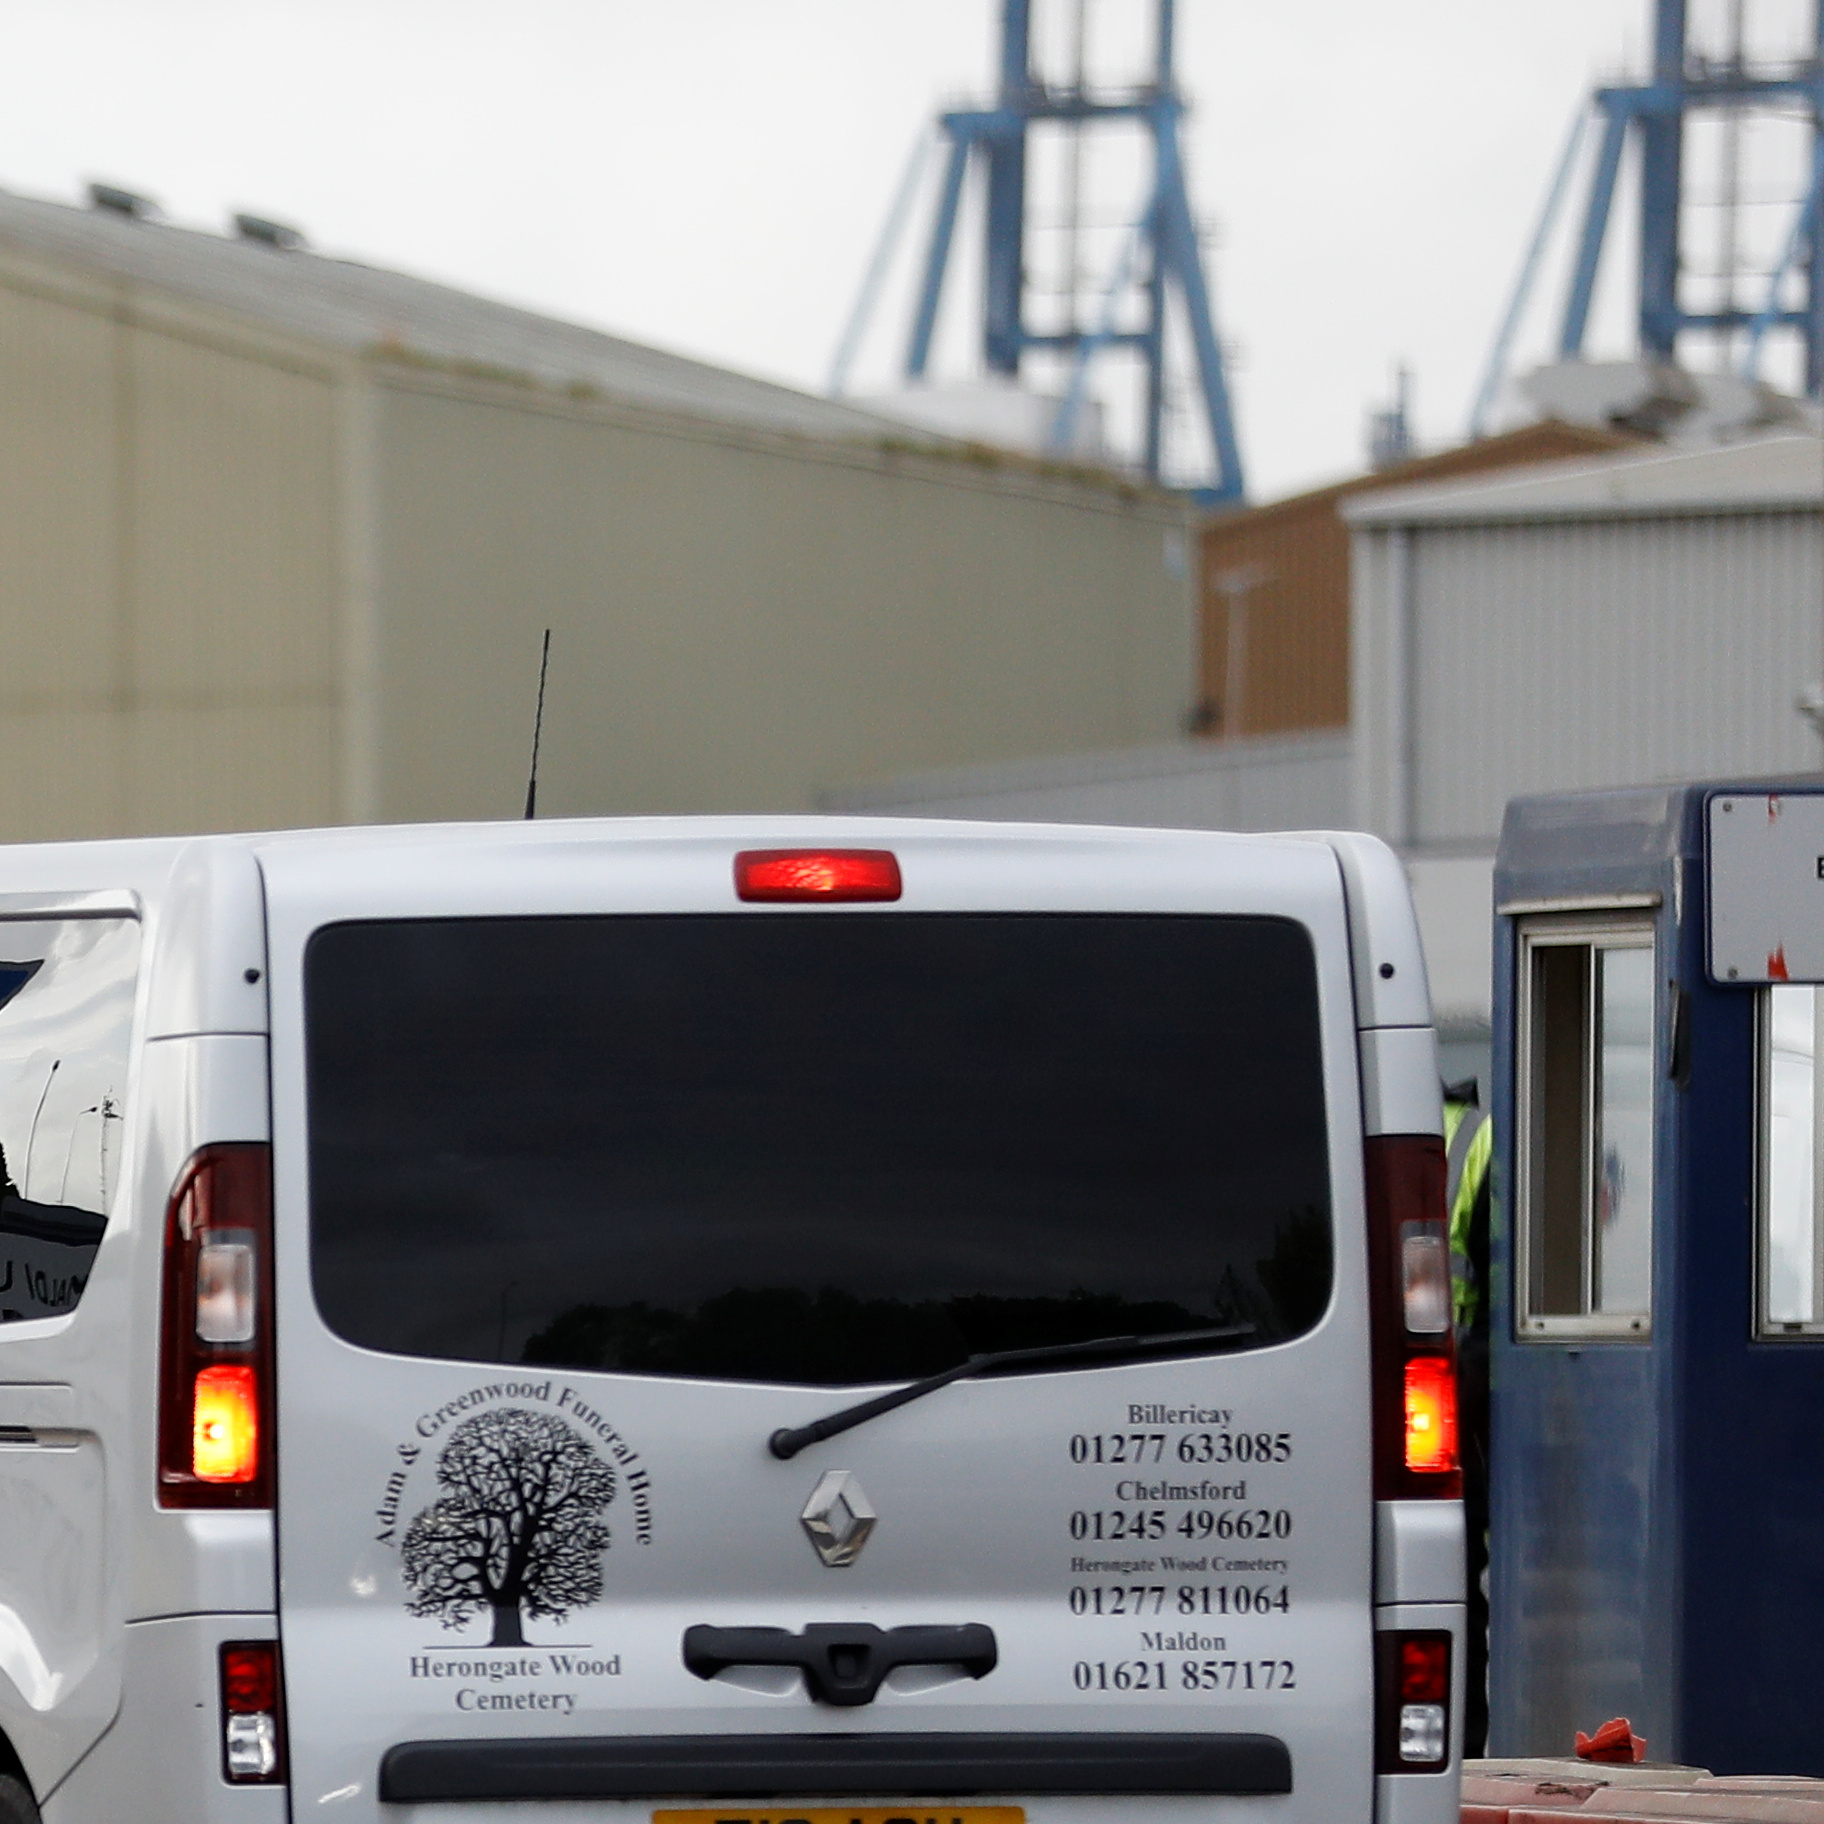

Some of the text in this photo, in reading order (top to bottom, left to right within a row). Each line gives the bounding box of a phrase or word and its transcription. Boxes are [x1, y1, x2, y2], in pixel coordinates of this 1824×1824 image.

[1128, 1404, 1233, 1428] Billericay
[1070, 1433, 1292, 1463] 01277 633085
[375, 1382, 651, 1547] Adam & Greenwood Funeral Home
[1116, 1480, 1246, 1500] Chelmsford
[1070, 1509, 1292, 1539] 01245 496620
[1071, 1557, 1288, 1575] Herongate Wood Cemetery
[1069, 1585, 1289, 1615] 01277 811064
[1142, 1632, 1226, 1651] Maldon
[410, 1655, 621, 1681] Herongate Wood
[1074, 1660, 1295, 1690] 01621 857172
[455, 1689, 577, 1715] Cemetery
